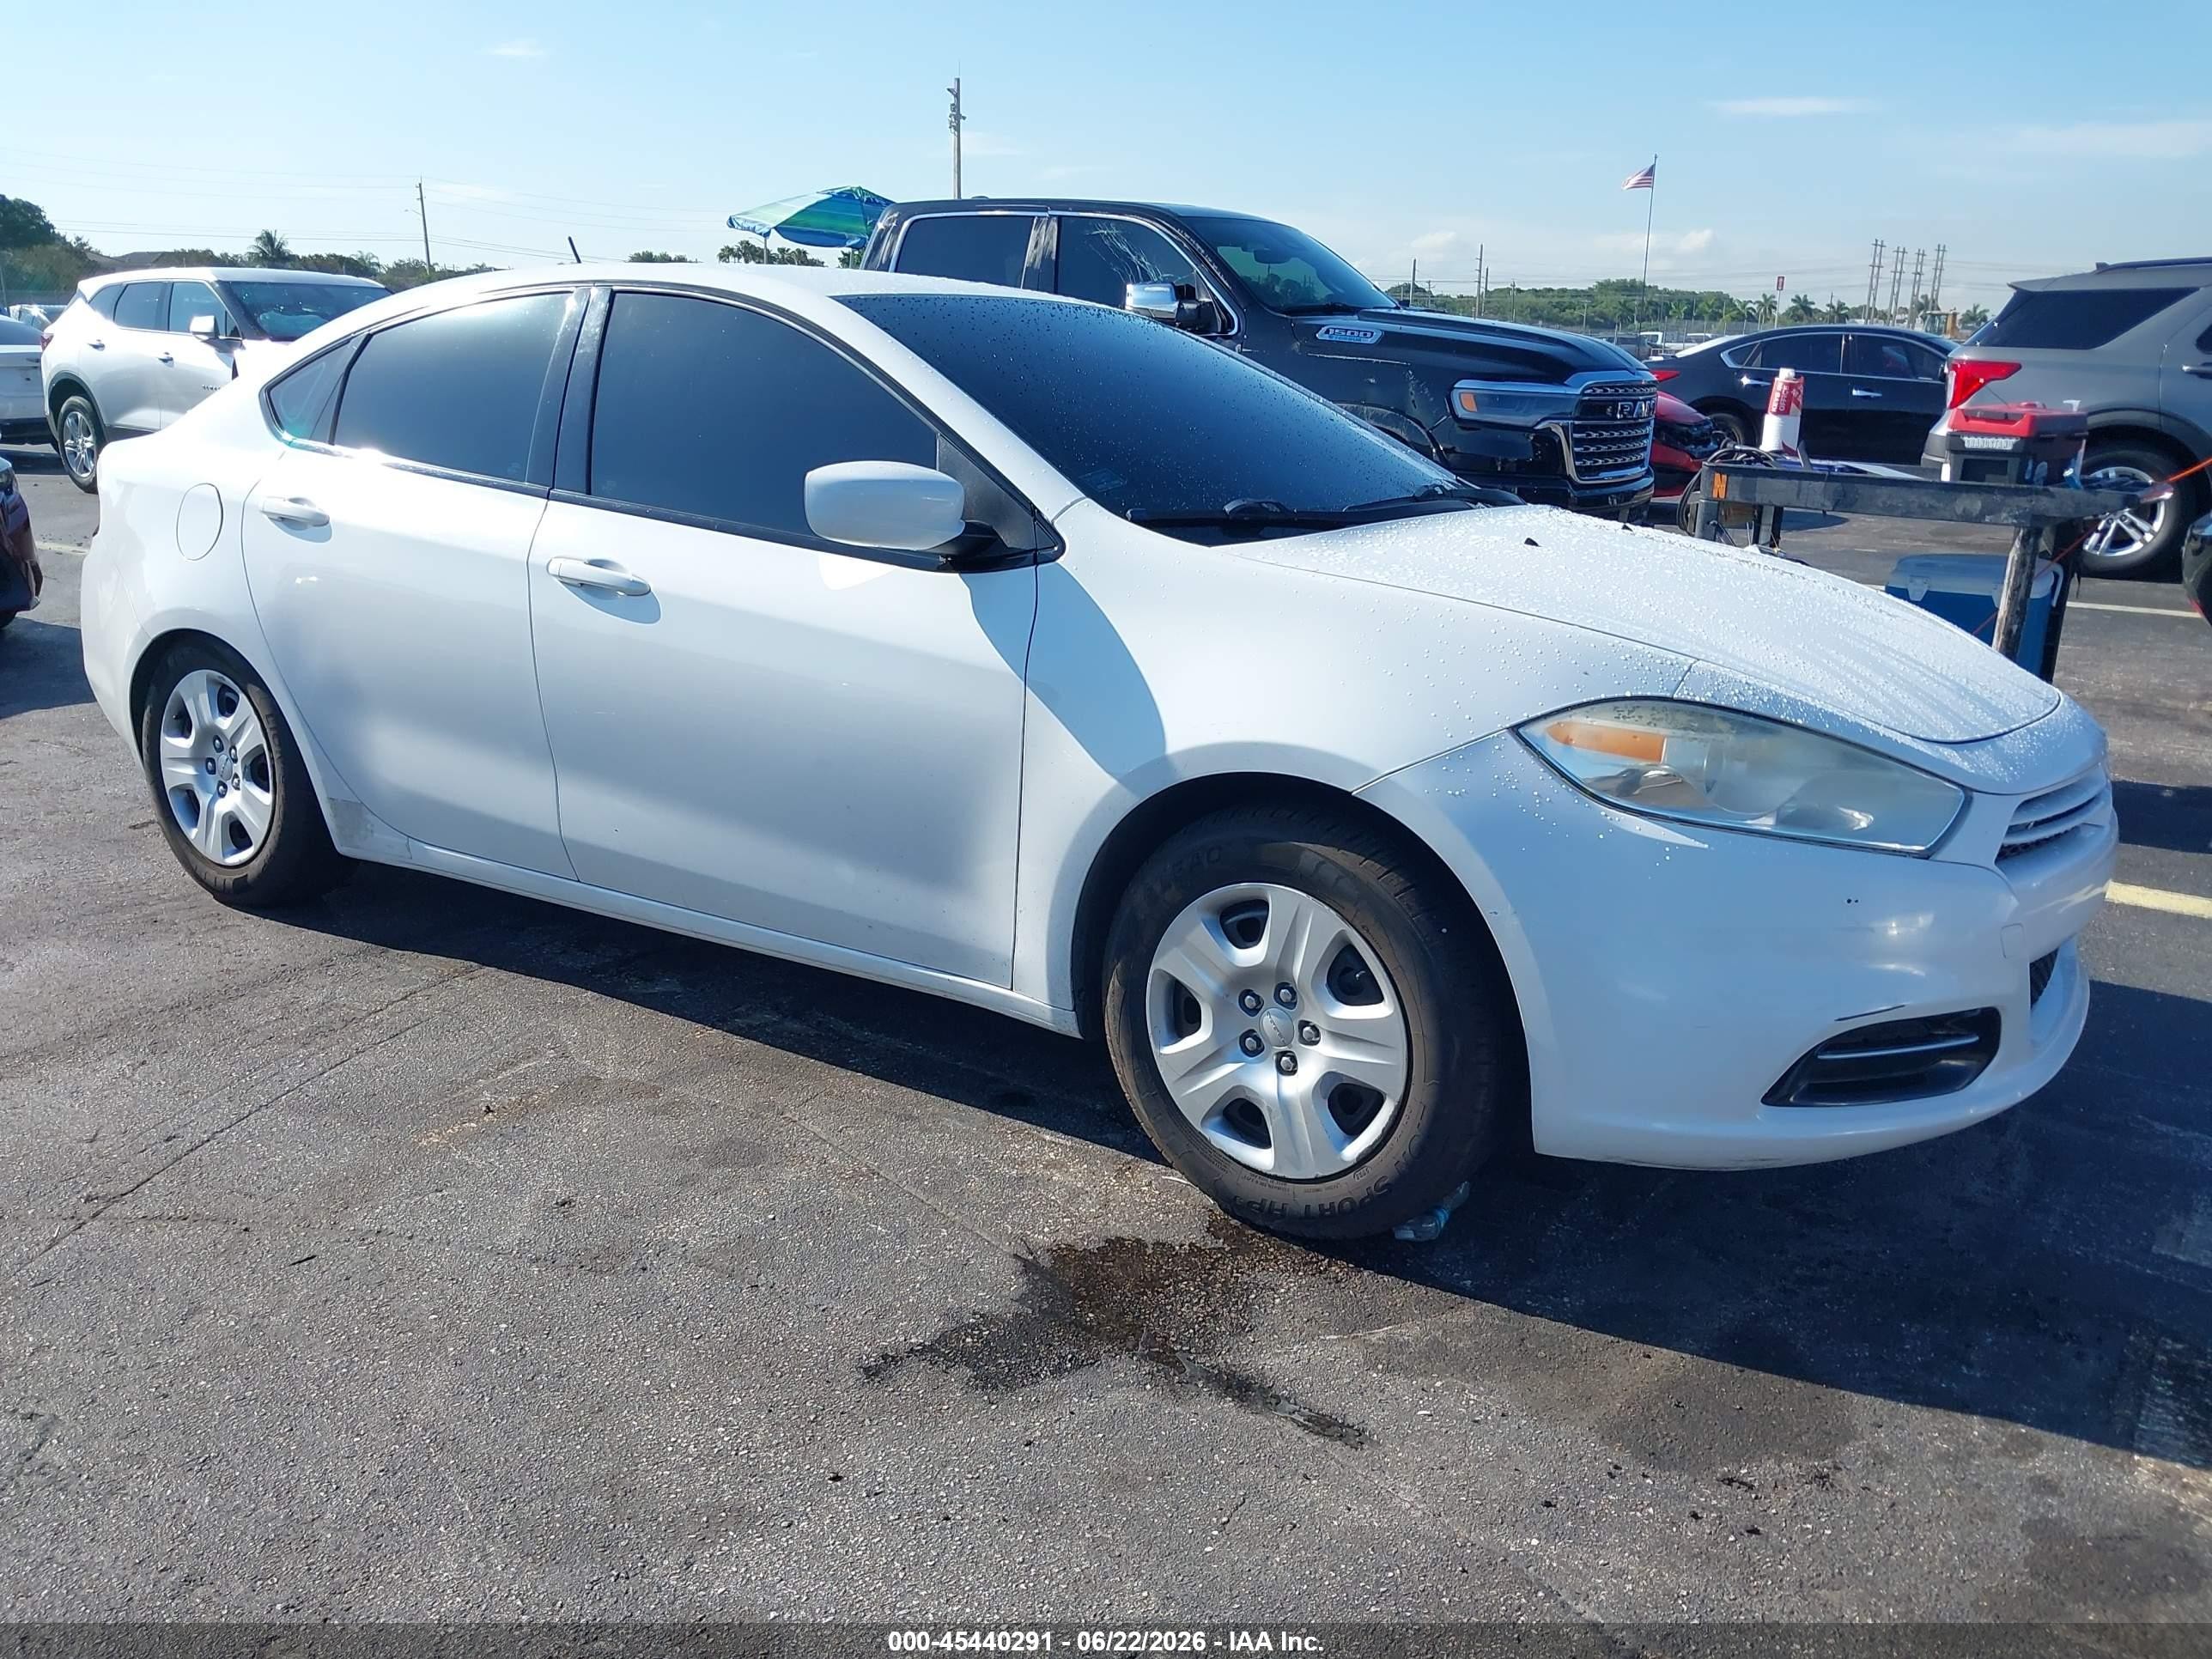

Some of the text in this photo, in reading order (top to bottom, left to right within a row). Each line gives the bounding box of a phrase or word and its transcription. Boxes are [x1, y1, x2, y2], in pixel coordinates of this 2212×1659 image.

[1328, 328, 1372, 338] 1500
[1616, 398, 1656, 420] RAM
[1778, 384, 1790, 412] OFFICE
